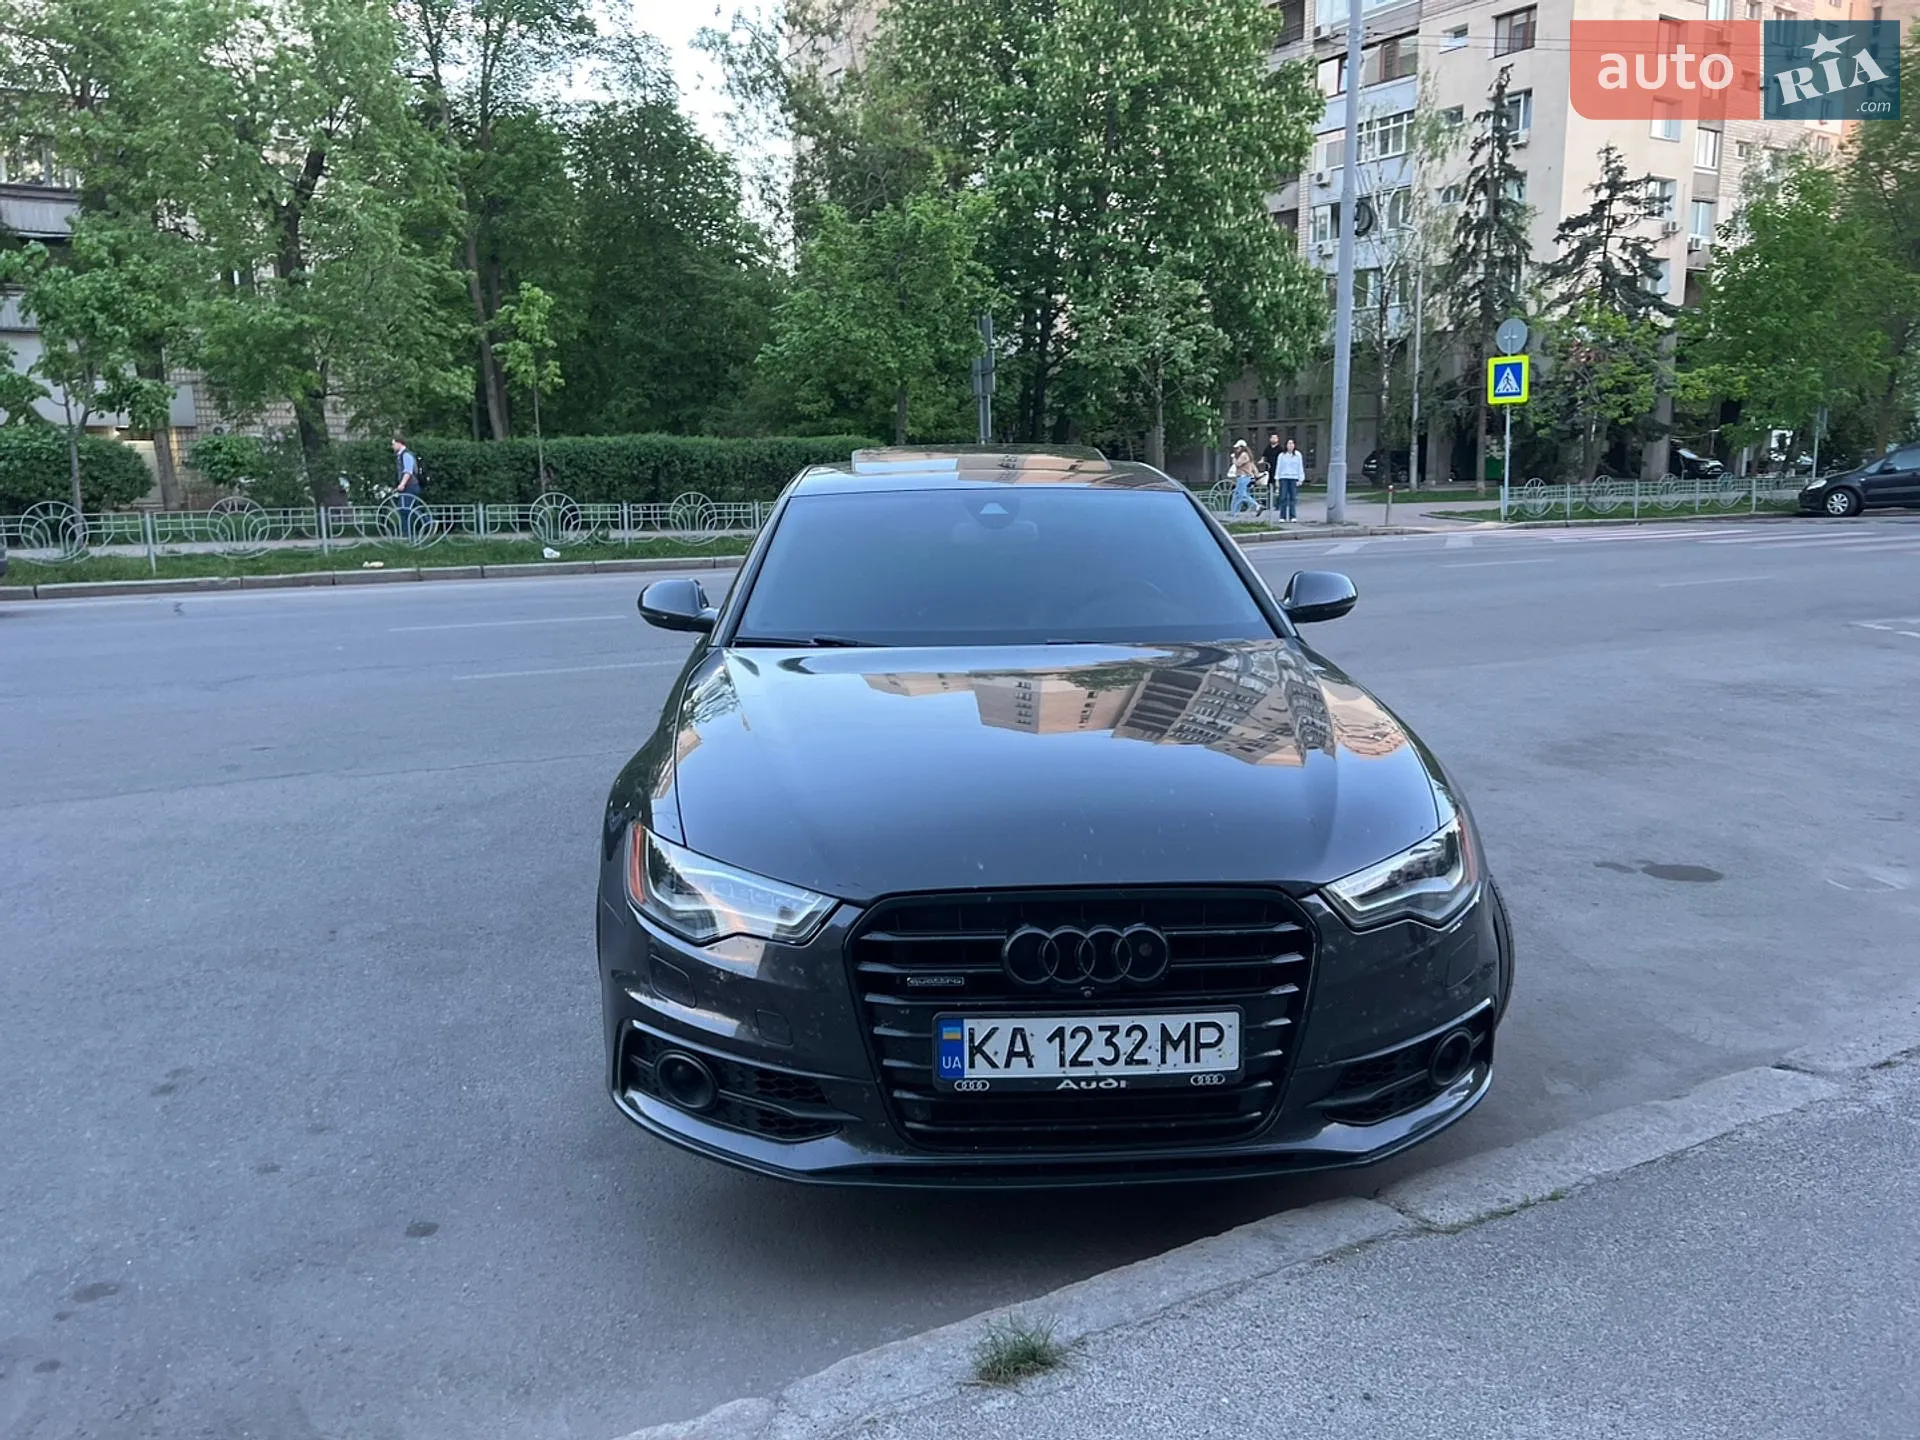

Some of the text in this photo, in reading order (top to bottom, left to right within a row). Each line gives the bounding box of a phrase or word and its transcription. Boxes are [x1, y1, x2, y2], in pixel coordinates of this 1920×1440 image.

[967, 1021, 1225, 1069] KA 1232 MP
[942, 1056, 962, 1069] UA
[1055, 1078, 1127, 1091] Audi
